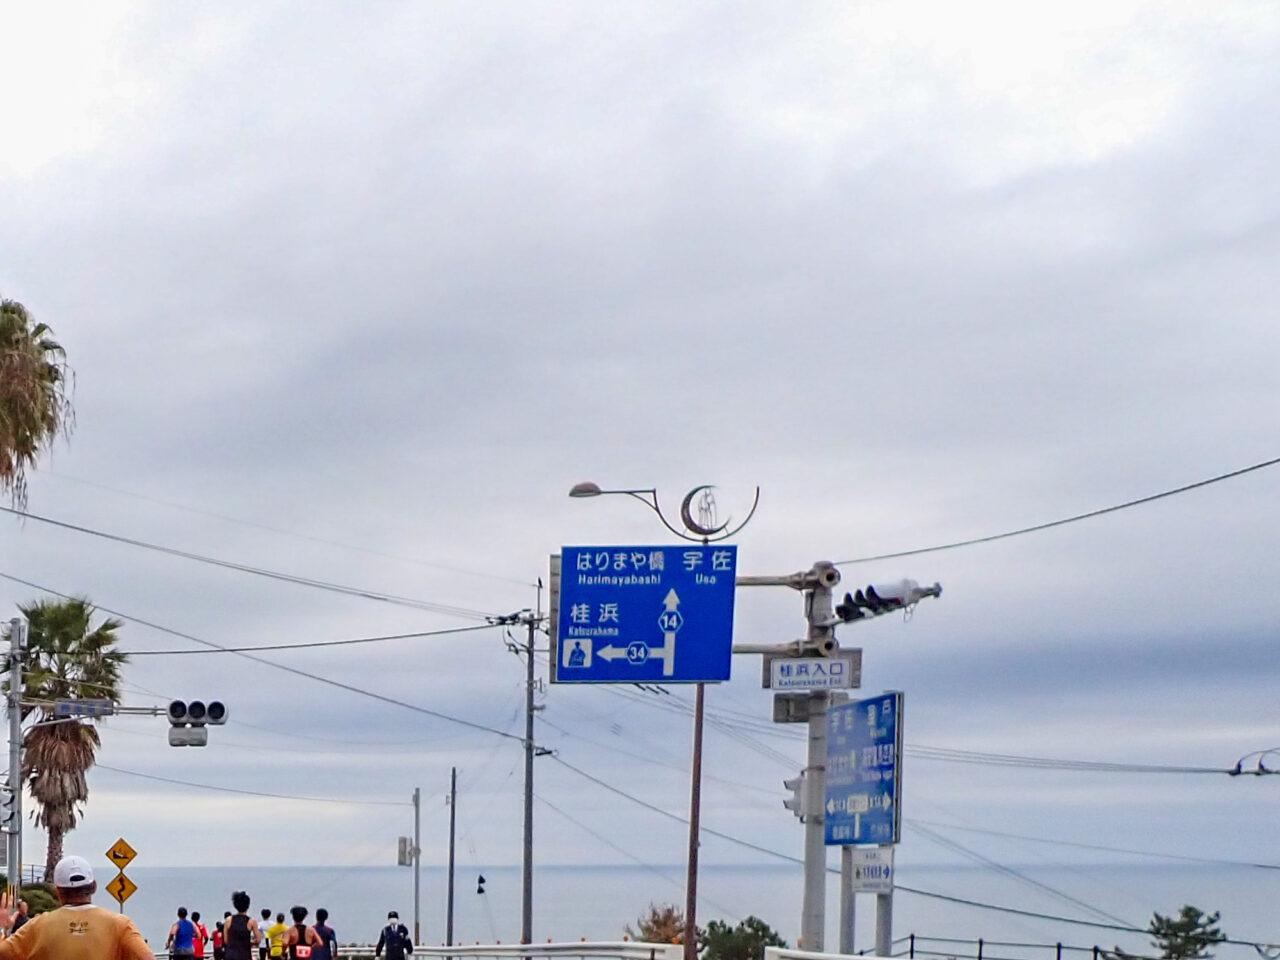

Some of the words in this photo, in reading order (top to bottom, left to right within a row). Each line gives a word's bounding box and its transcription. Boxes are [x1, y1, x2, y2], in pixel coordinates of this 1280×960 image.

[576, 552, 664, 571] はりまや橋
[683, 551, 732, 571] 宇佐
[570, 603, 619, 623] 桂浜
[662, 616, 678, 628] 14
[629, 647, 645, 659] 34
